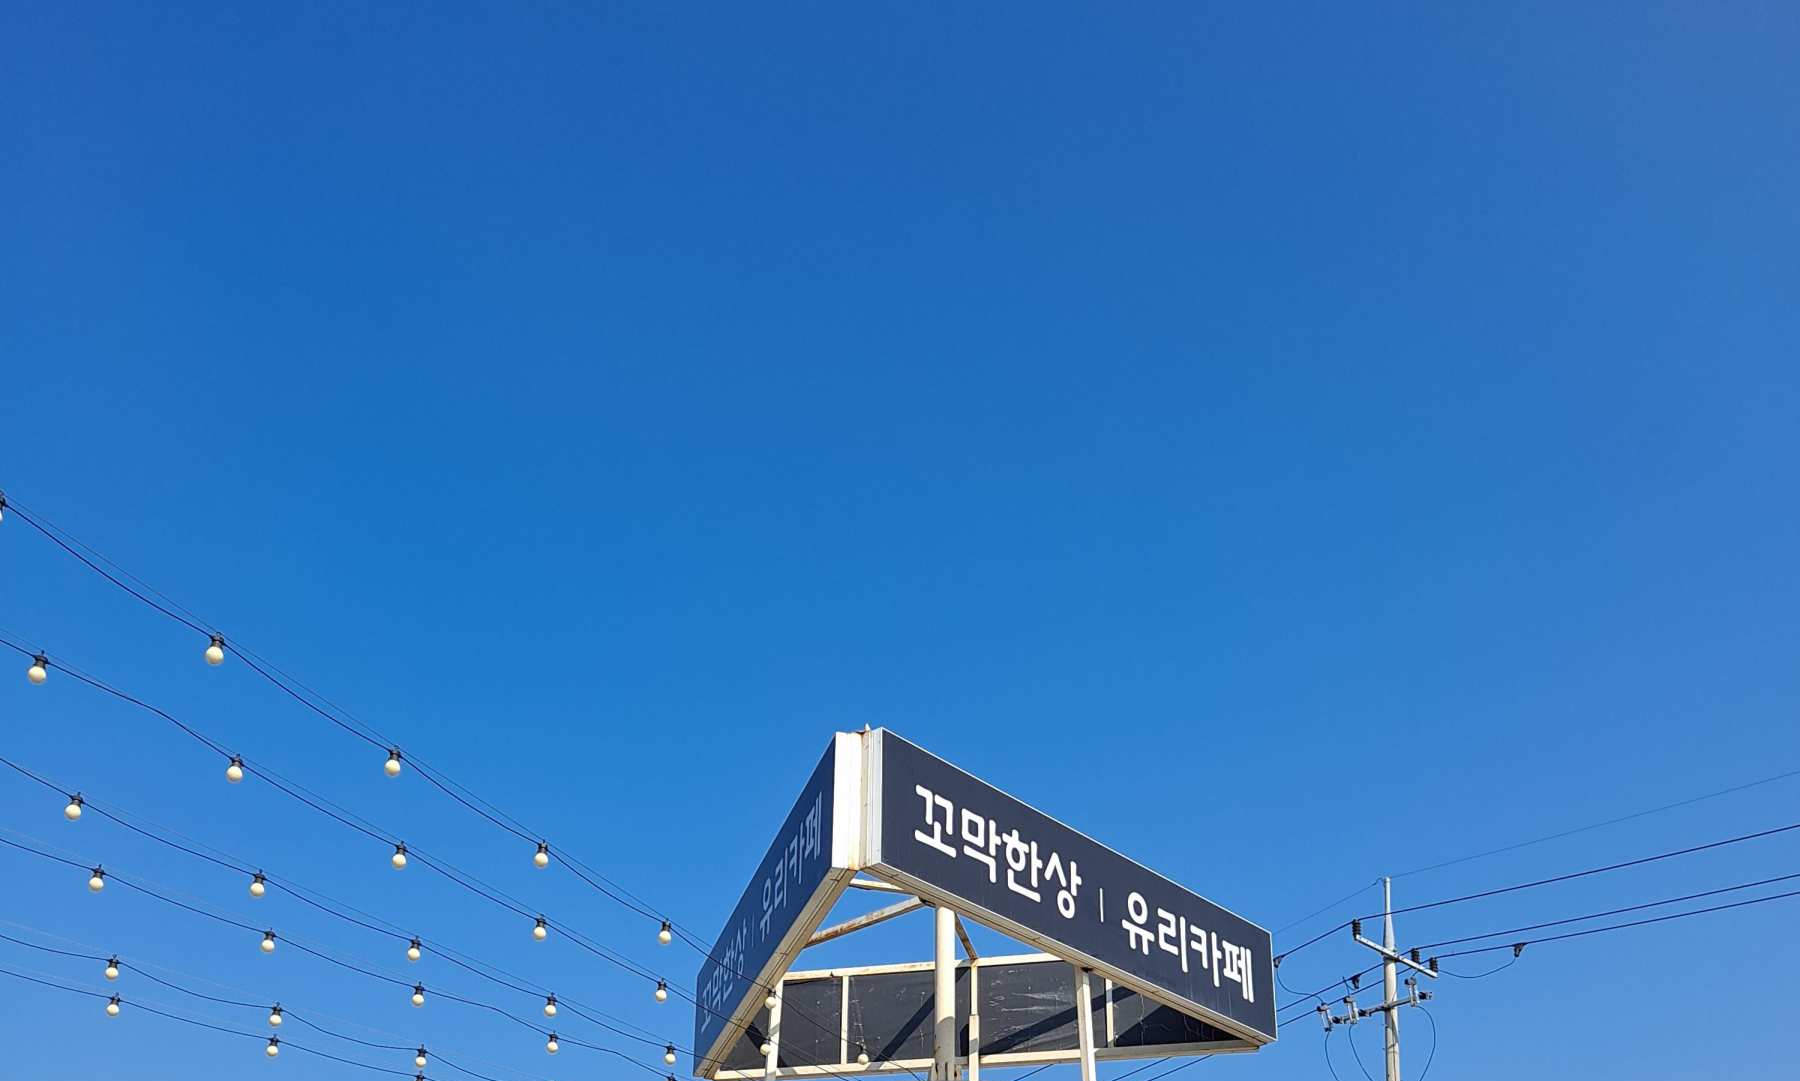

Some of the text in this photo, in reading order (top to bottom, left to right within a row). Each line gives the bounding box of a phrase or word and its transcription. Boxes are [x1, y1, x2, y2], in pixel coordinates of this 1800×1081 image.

[759, 791, 823, 943] 유리카페
[915, 783, 1255, 1003] 꼬막한상 유리카페
